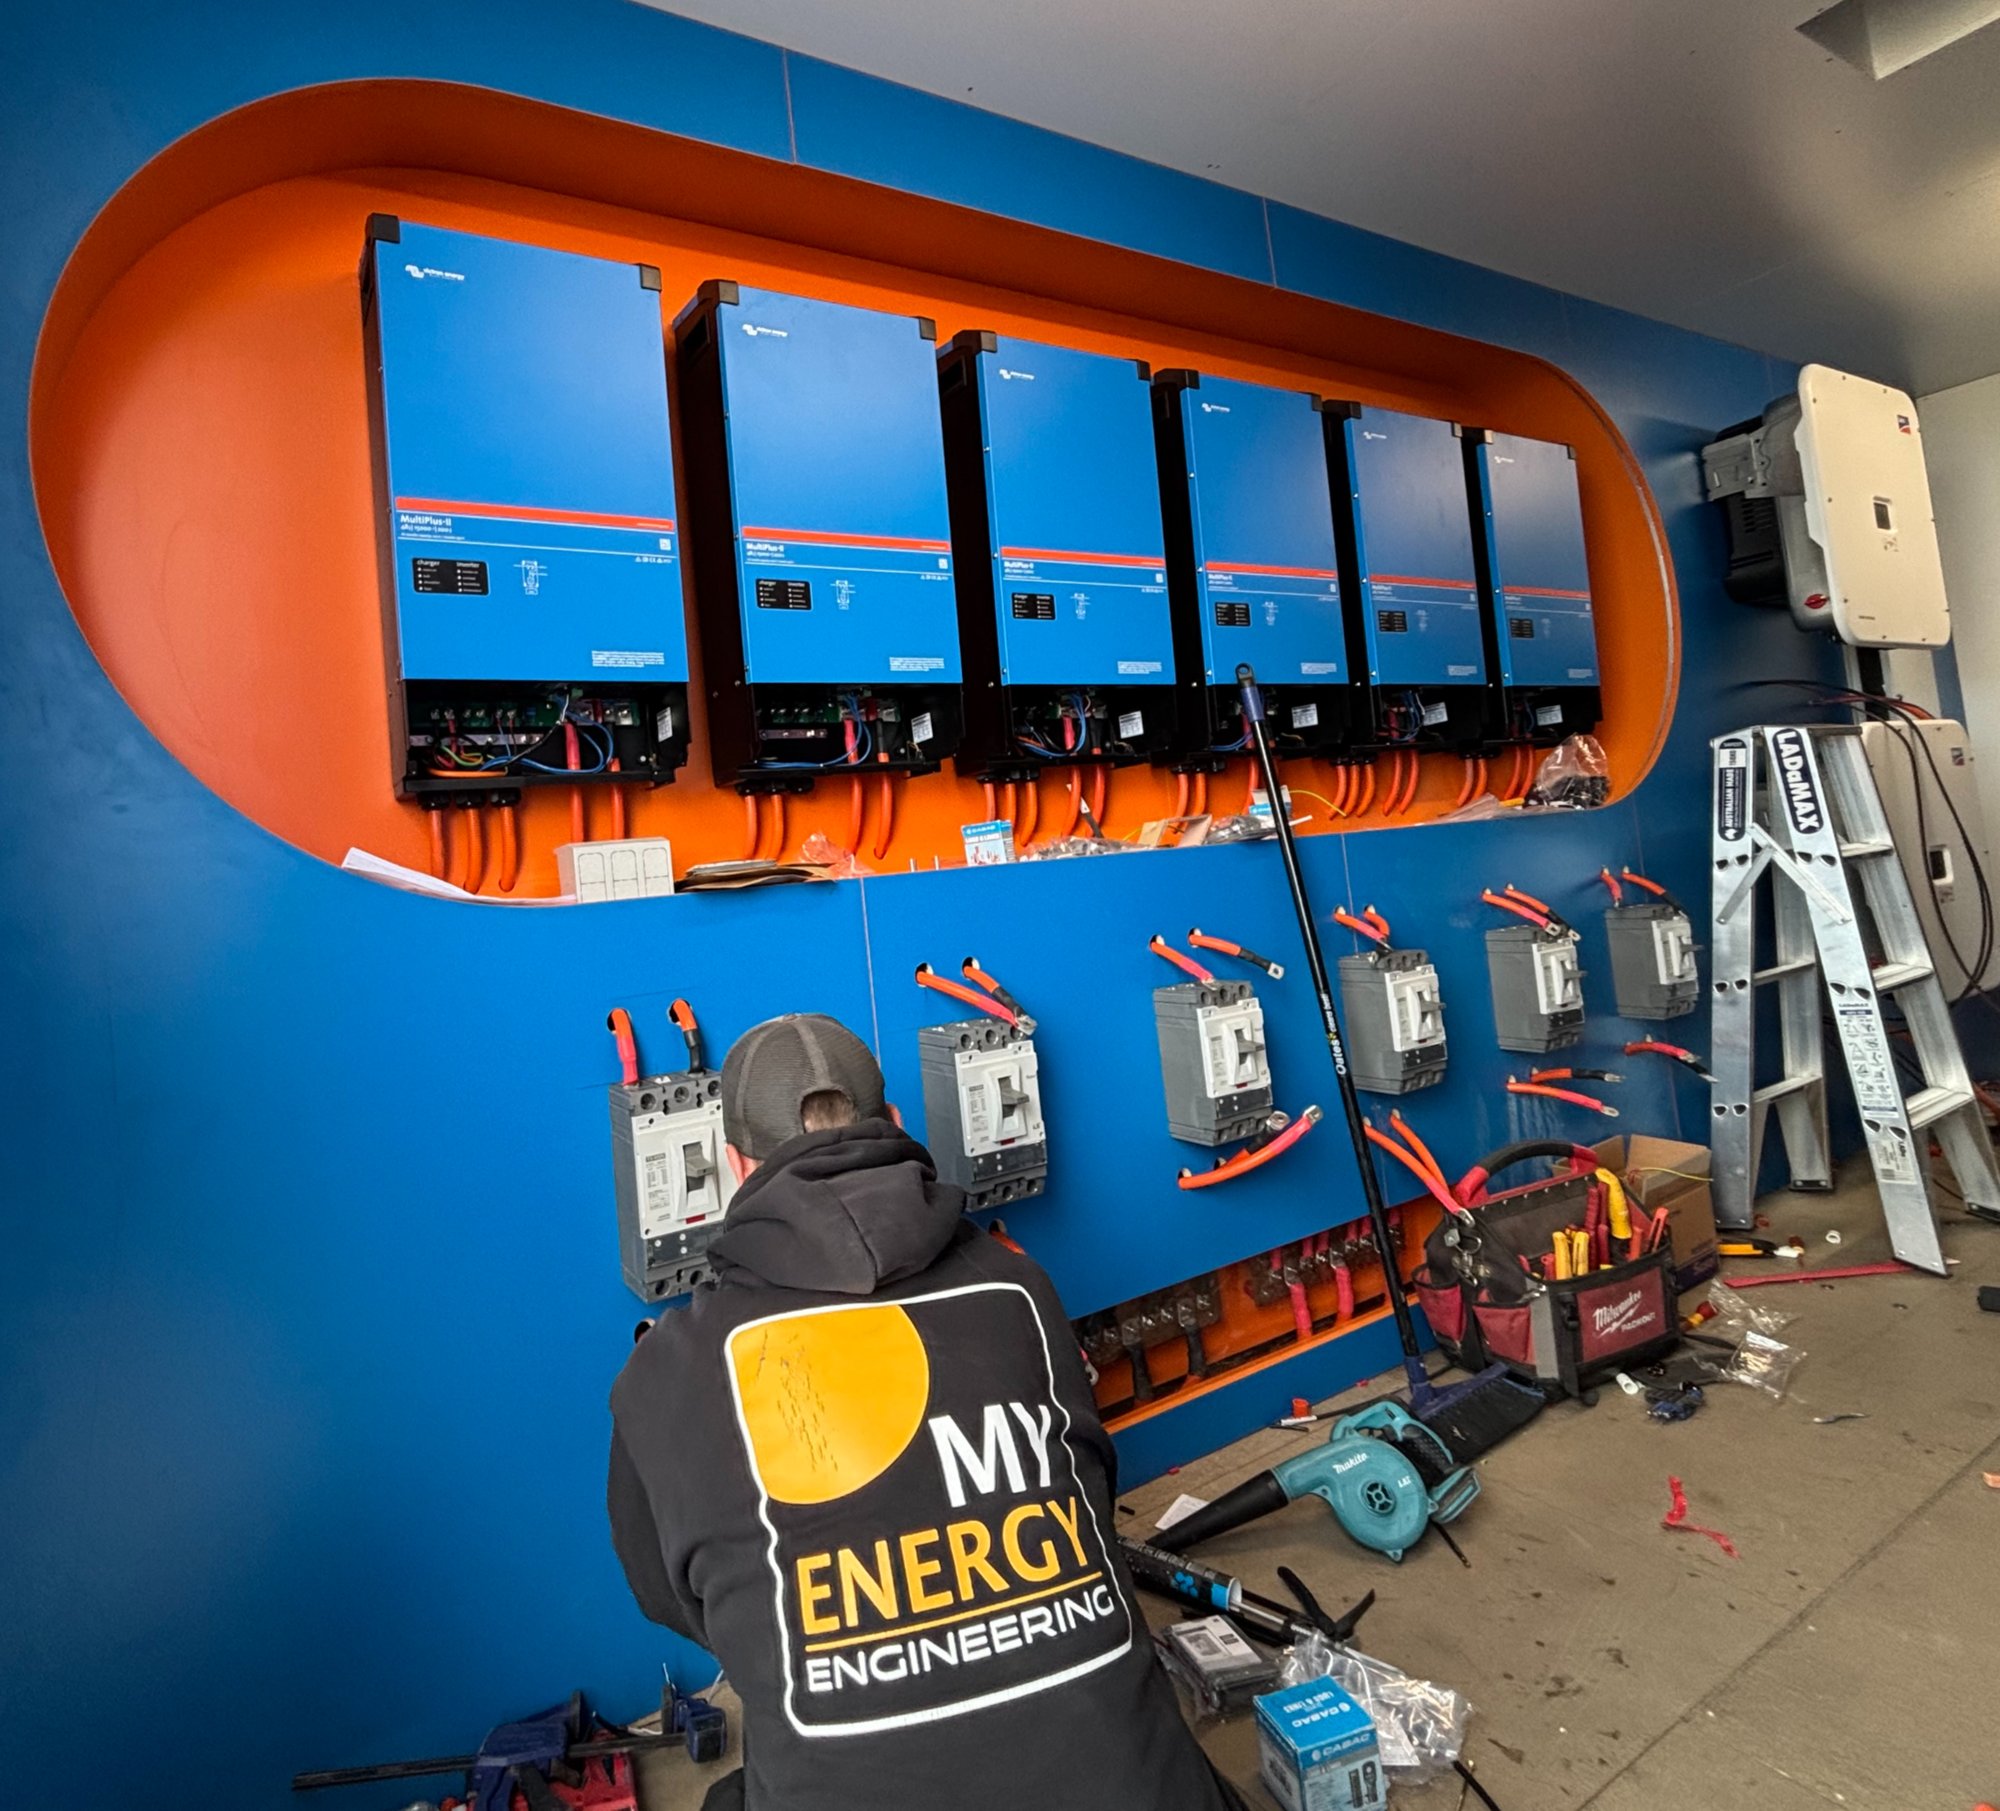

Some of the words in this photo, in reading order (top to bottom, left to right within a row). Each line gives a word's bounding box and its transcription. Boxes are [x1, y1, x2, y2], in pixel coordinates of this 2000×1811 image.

[1725, 769, 1735, 787] MADE
[1725, 788, 1734, 828] AUSTRALIAN
[1331, 1039, 1347, 1075] Oates
[1592, 1290, 1642, 1331] Milwaukee
[928, 1402, 1051, 1507] MY
[796, 1496, 1088, 1635] ENERGY
[805, 1584, 1115, 1692] ENGINEERING
[1291, 1706, 1341, 1728] CABAC
[1322, 1733, 1370, 1757] CABAC
